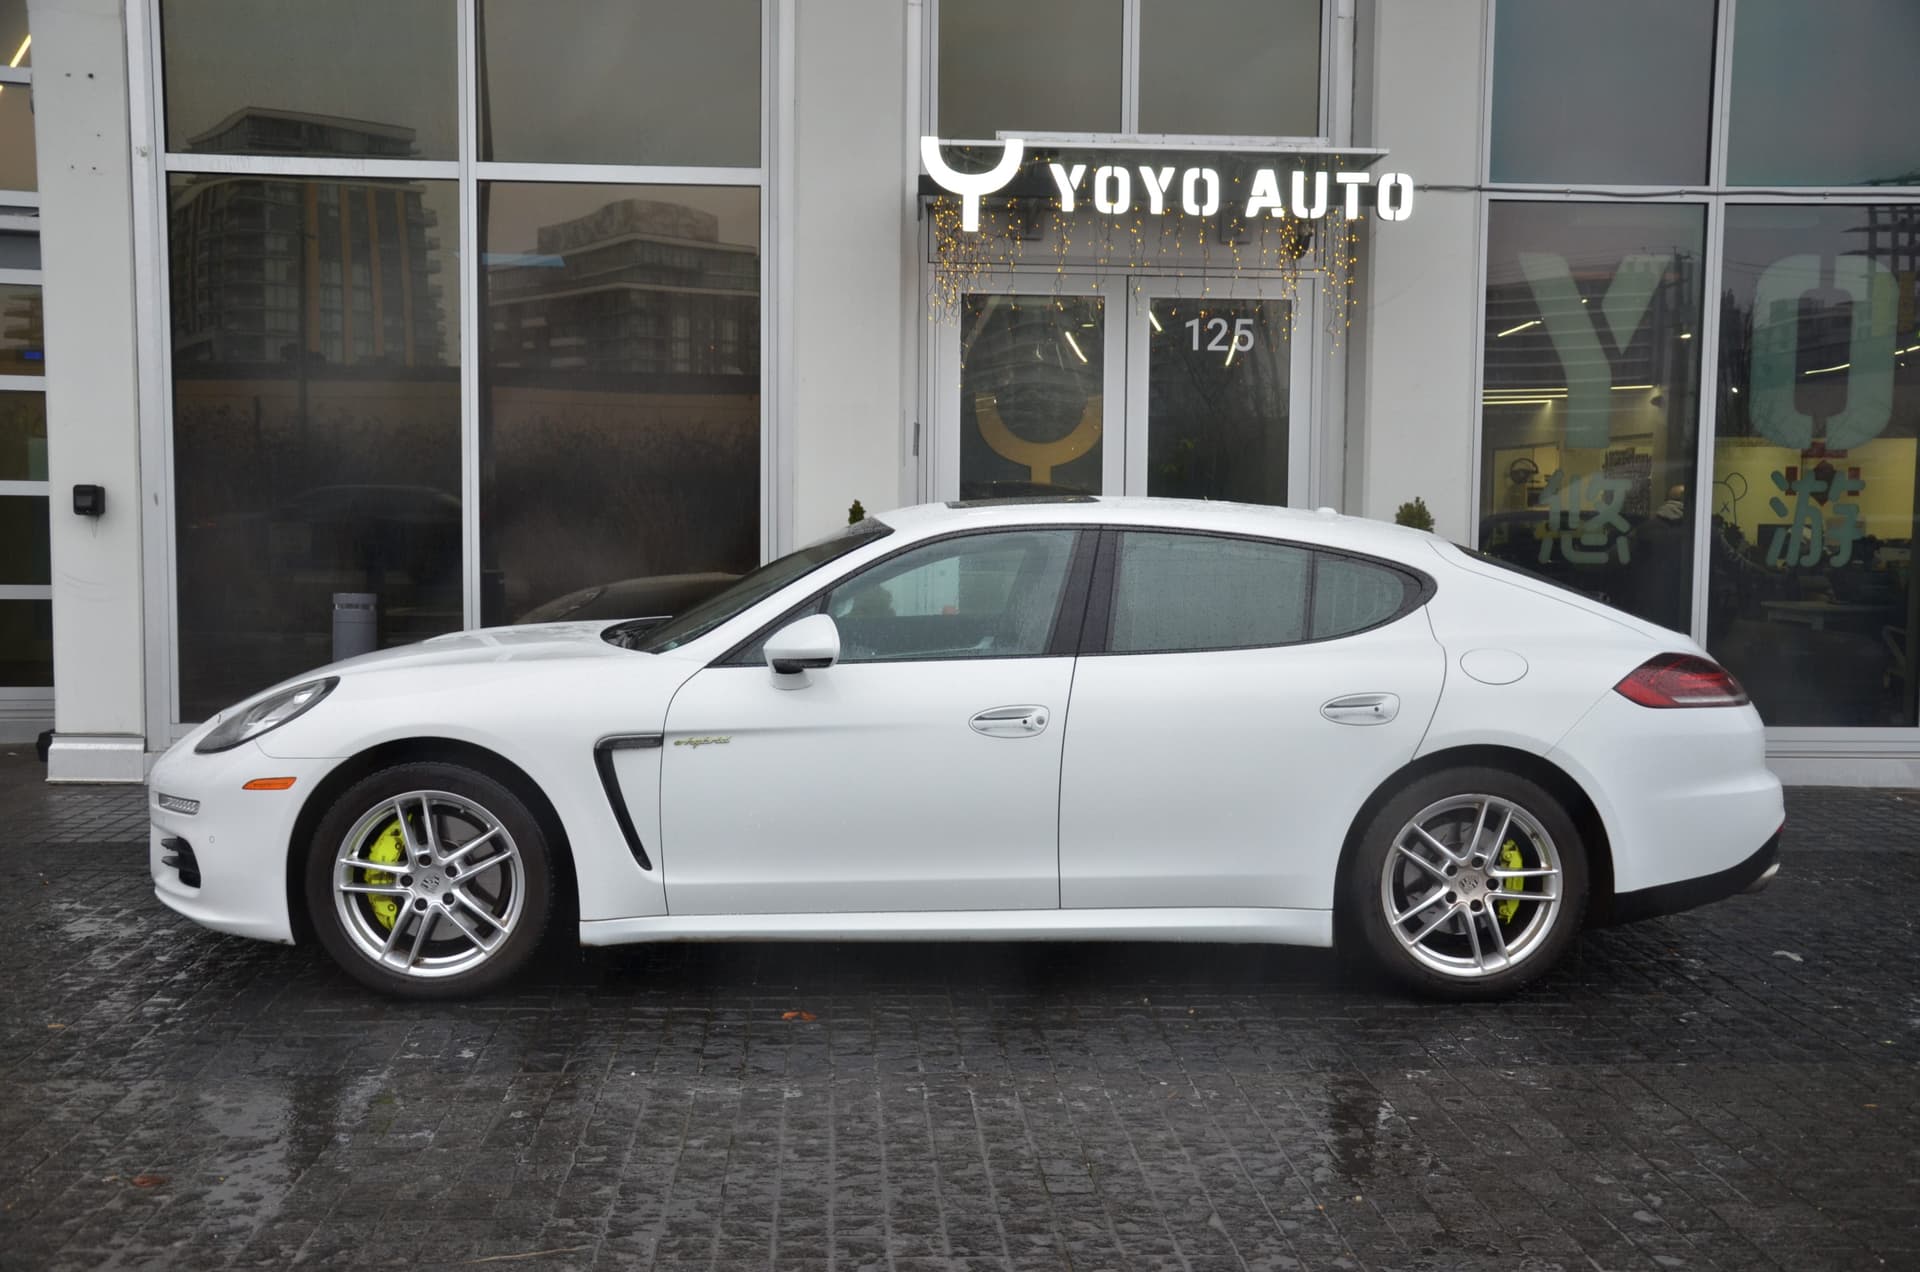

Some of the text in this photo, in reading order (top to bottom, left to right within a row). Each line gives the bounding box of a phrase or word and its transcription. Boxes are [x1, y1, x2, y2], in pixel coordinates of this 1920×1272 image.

[1050, 163, 1414, 221] YOYO AUTO
[1185, 318, 1255, 351] 125
